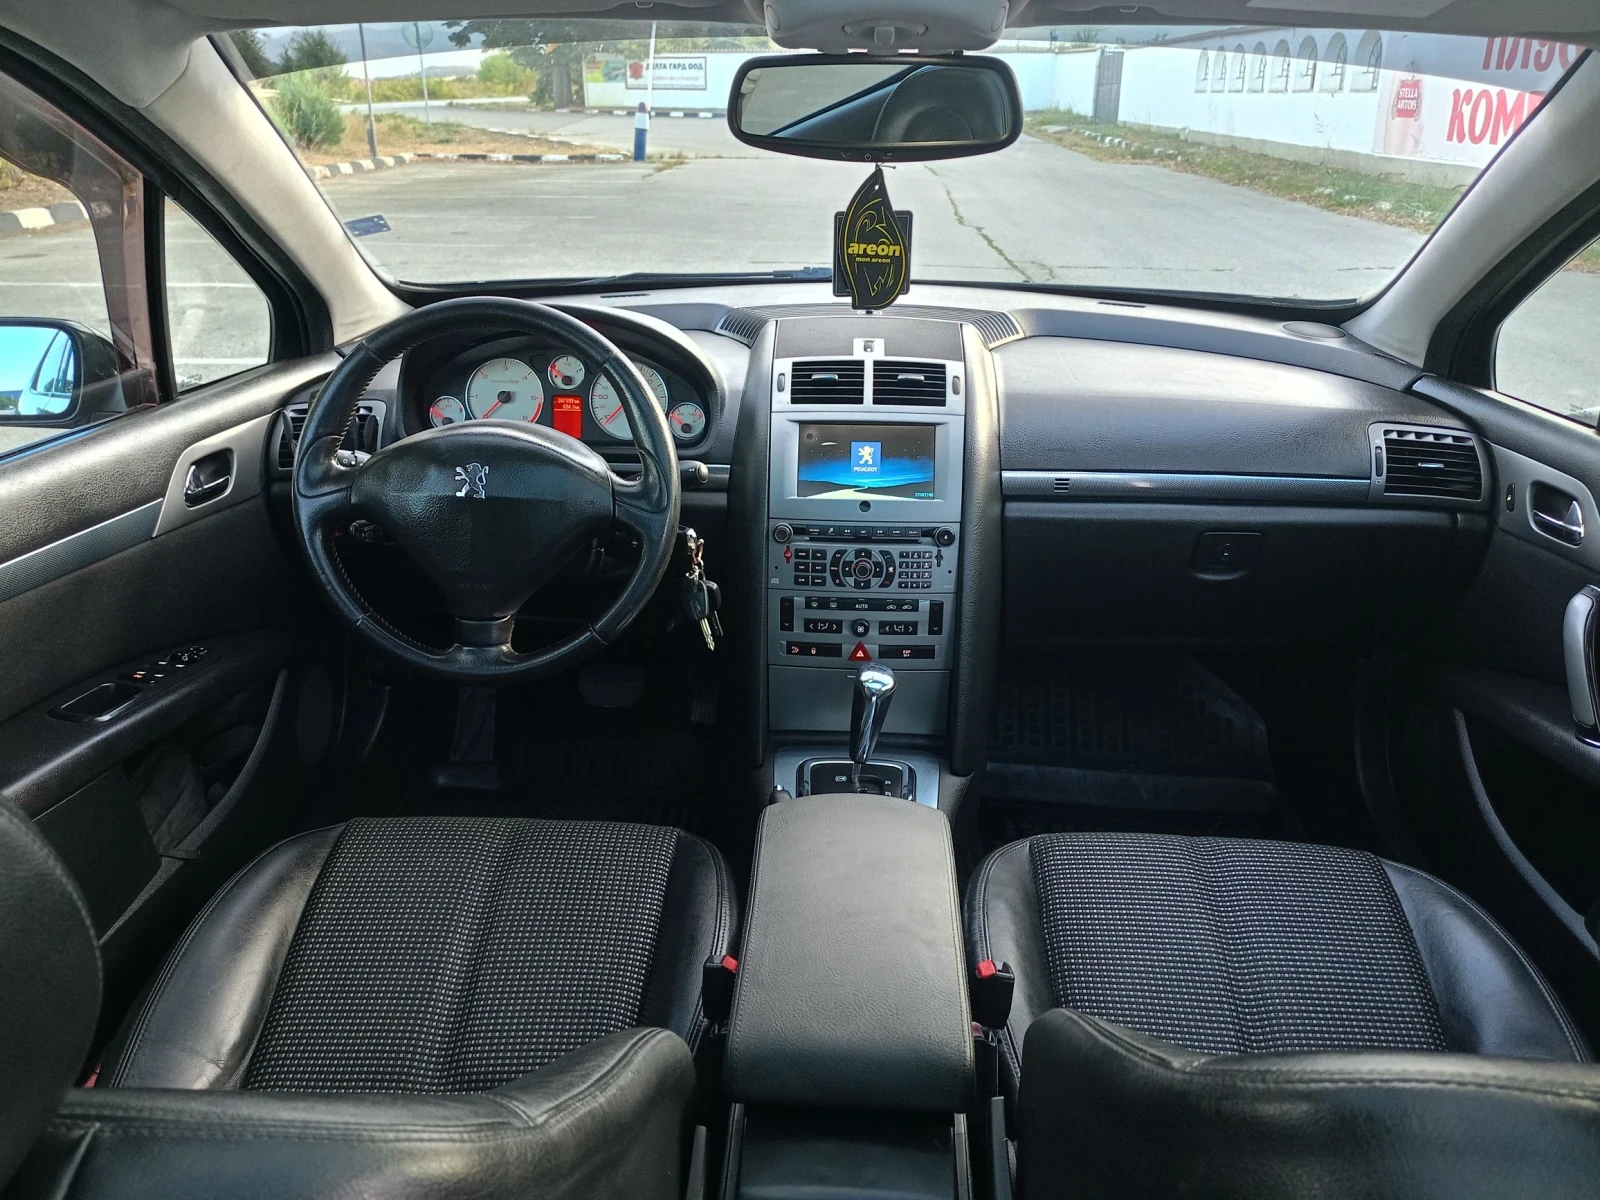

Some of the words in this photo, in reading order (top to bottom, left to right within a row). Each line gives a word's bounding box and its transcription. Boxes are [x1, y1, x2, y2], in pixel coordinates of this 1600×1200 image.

[1399, 87, 1418, 98] STELLA
[1397, 100, 1417, 111] ARTOIS
[1446, 88, 1547, 145] КОМ
[848, 243, 900, 256] areon
